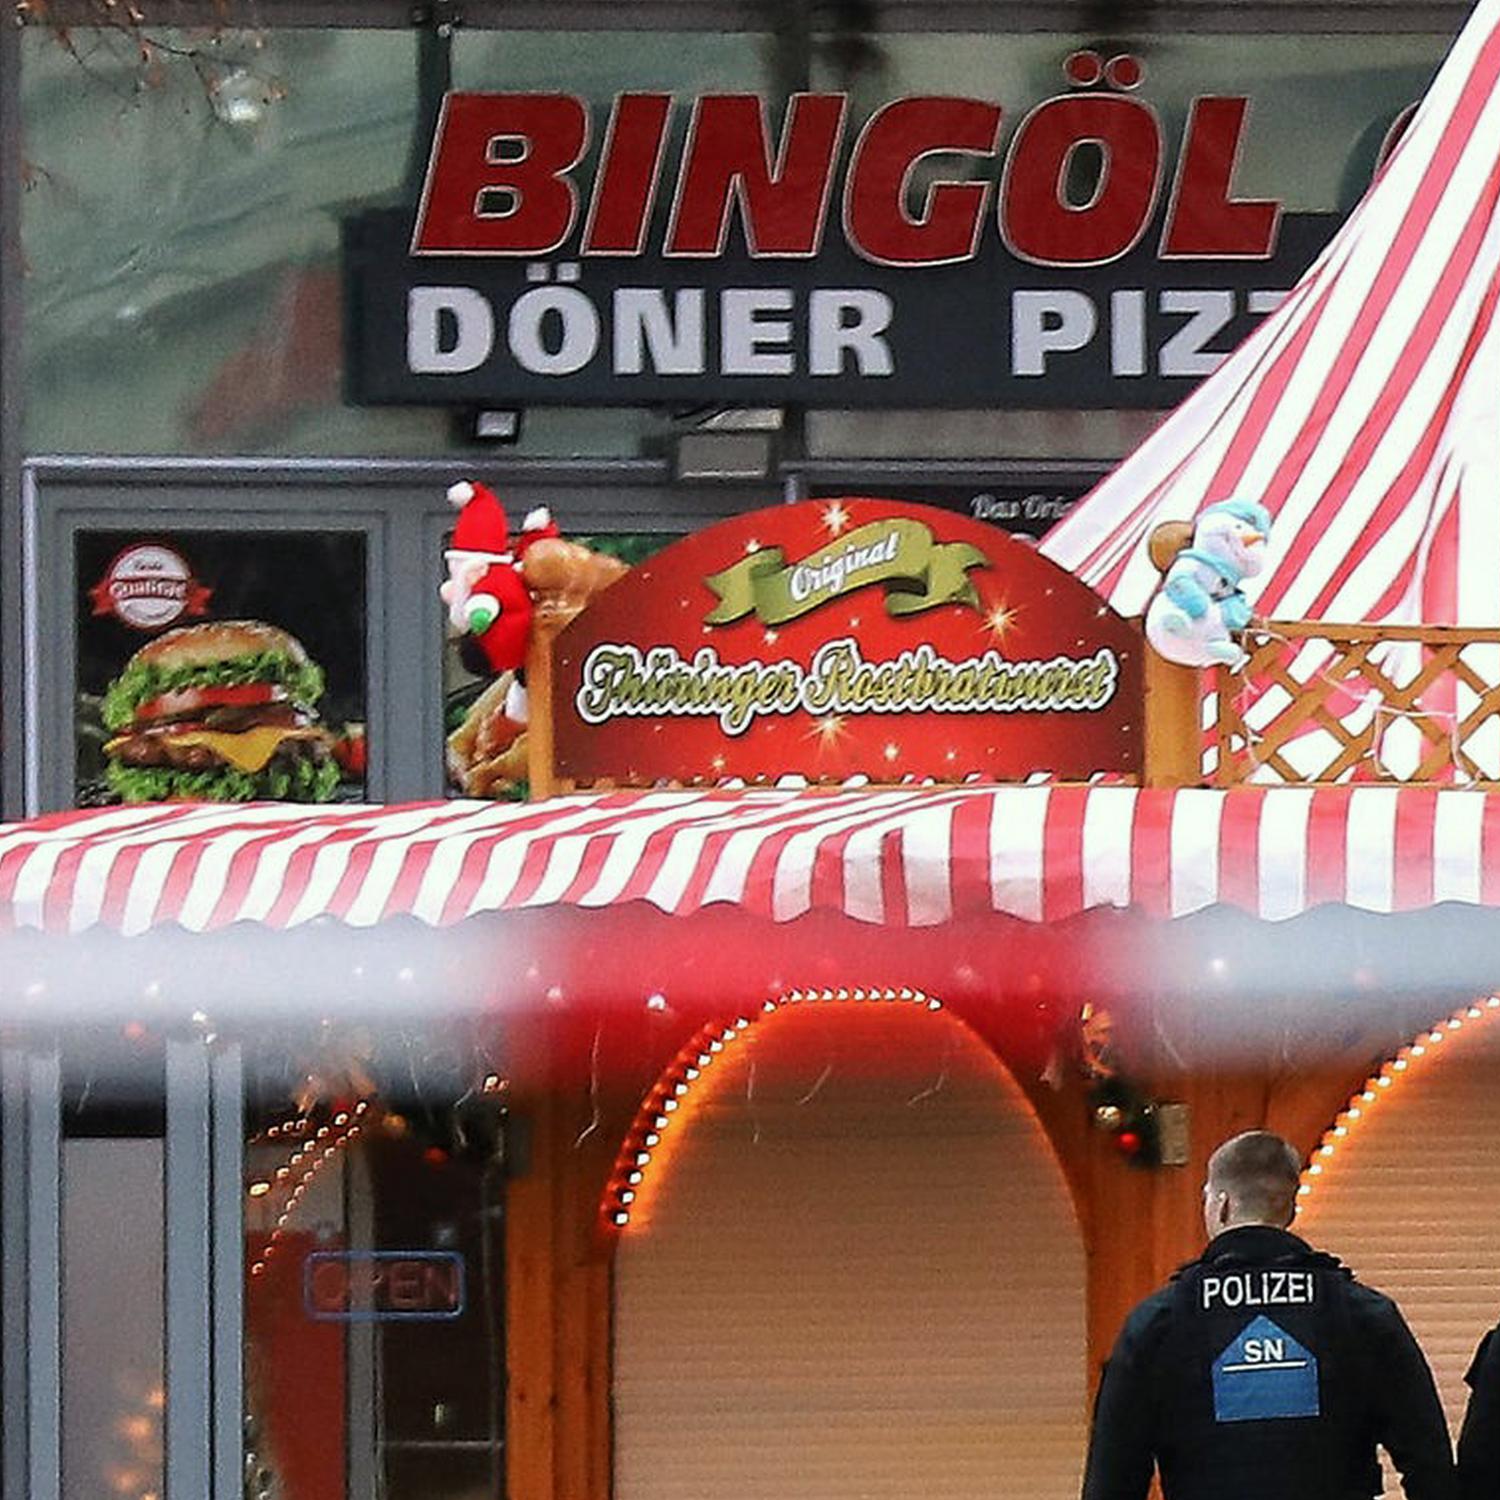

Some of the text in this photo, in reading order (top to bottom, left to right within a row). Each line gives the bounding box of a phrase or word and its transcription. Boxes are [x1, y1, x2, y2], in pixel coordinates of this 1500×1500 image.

[411, 49, 1284, 268] BINGÖL
[406, 261, 896, 377] DÖNER
[790, 531, 900, 602] Original
[576, 637, 1116, 736] Thüringer Rostbratwurst
[1202, 1271, 1315, 1308] POLIZEI
[1243, 1338, 1284, 1363] SN
